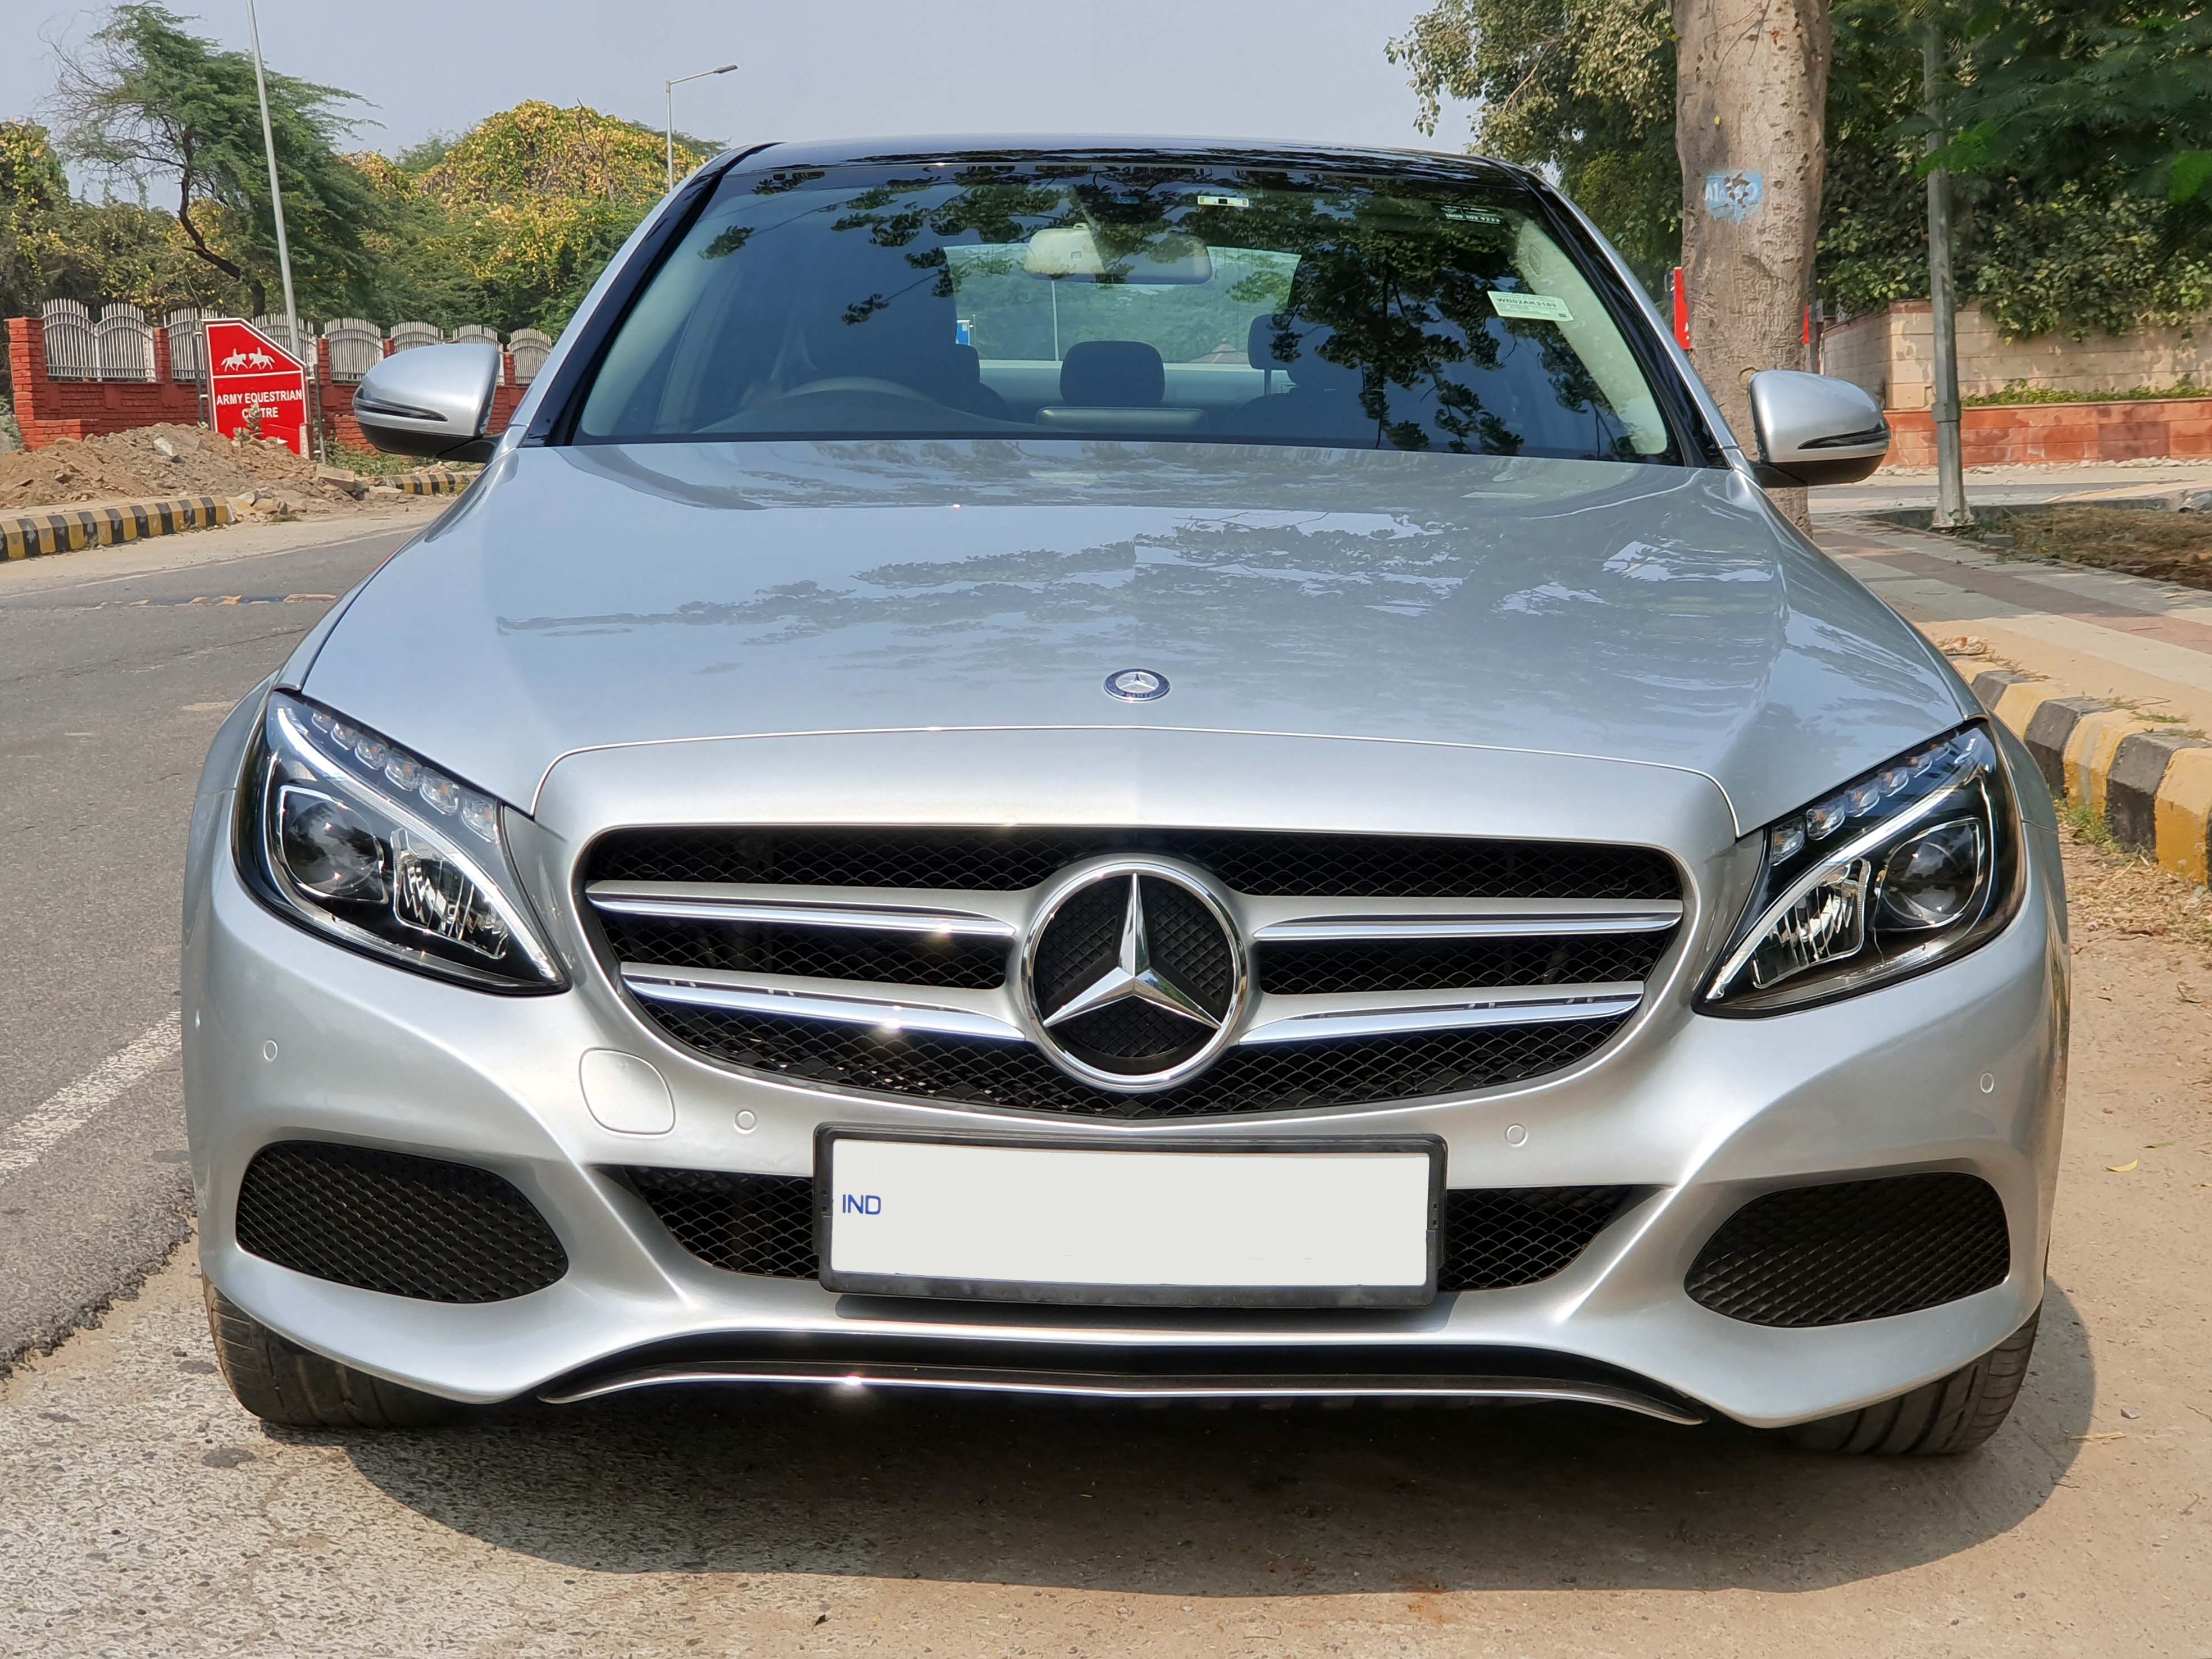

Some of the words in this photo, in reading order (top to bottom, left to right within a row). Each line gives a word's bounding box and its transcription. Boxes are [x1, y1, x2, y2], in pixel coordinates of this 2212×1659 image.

[217, 393, 243, 405] ARMY
[245, 389, 302, 404] EQUESTRIAN
[242, 407, 279, 419] CTRE
[843, 1194, 881, 1215] IND
